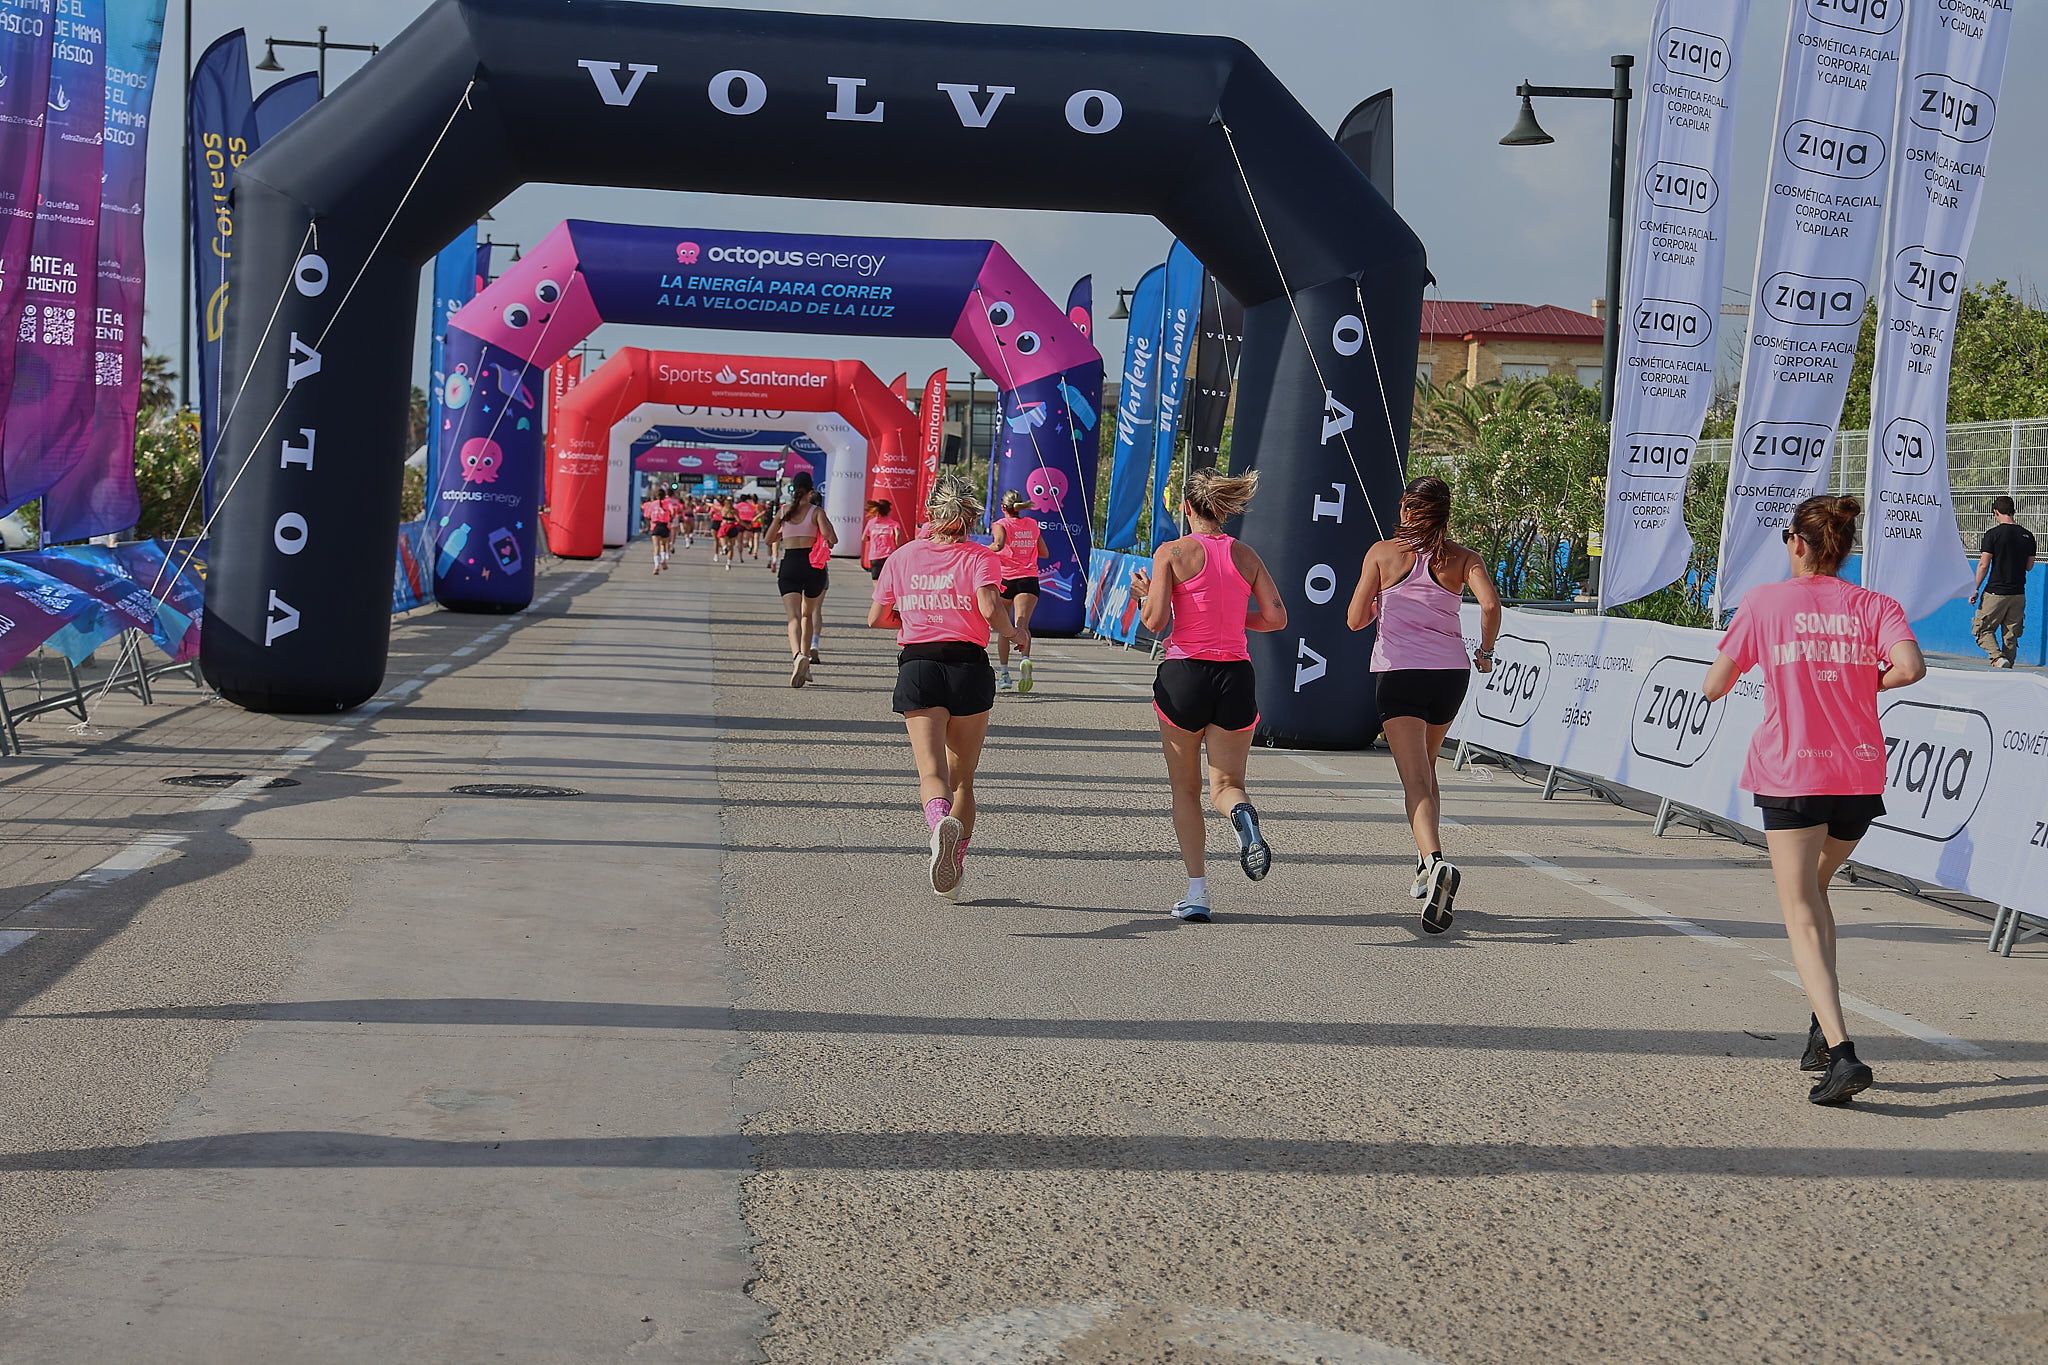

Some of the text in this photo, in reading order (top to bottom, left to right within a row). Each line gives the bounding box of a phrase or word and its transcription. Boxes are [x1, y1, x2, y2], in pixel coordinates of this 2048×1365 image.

[1940, 15, 1949, 28] Y
[72, 23, 102, 44] MAMA
[1797, 33, 1857, 56] COSMÉTICA
[1668, 39, 1722, 74] ziaja
[1817, 54, 1871, 76] CORPORAL
[1817, 70, 1867, 91] Y CAPILAR
[113, 90, 128, 105] EL
[577, 59, 1124, 135] VOLVO
[112, 109, 146, 129] MAMA
[1668, 101, 1712, 119] CORPORAL
[1920, 89, 1978, 132] ziaja
[1668, 115, 1710, 132] Y CAPILAR
[61, 132, 96, 146] AstraZeneca
[1796, 133, 1868, 171] ziaja
[1654, 173, 1707, 206] ziaja
[1774, 183, 1882, 208] COSMÉTICA FACIAL,
[1926, 186, 1933, 199] Y
[1795, 204, 1854, 222] CORPORAL
[1795, 220, 1849, 237] Y CAPILAR
[1652, 237, 1698, 253] CORPORAL
[707, 246, 886, 277] octopus energy
[1653, 251, 1696, 266] Y CAPILAR
[63, 262, 78, 277] AL
[660, 274, 893, 301] LA ENERGÍA PARA CORRER
[657, 293, 895, 318] A LA VELOCIDAD DE LA LUZ
[1775, 285, 1852, 320] ziaja
[113, 313, 124, 327] AL
[1639, 310, 1697, 341] ziaja
[1753, 335, 1818, 352] COSMÉTICA
[1676, 361, 1712, 373] FACIAL,
[1774, 354, 1838, 369] CORPORAL
[659, 364, 827, 388] Sports Santander
[1640, 372, 1689, 385] CORPORAL
[1773, 370, 1834, 383] Y CAPILAR
[1118, 336, 1152, 446] Marlene
[1642, 386, 1687, 399] Y CAPILAR
[927, 380, 942, 453] Santander
[816, 424, 850, 432] OYSHO
[265, 253, 329, 647] VOLVO
[566, 451, 604, 461] Santander
[1629, 445, 1689, 472] ziaja
[1752, 434, 1826, 466] ziaja
[880, 465, 917, 475] Santander
[442, 488, 522, 507] octopus energy
[1617, 489, 1666, 501] OSMÉTICA
[1734, 483, 1795, 498] COSMÉTICA
[1294, 314, 1364, 692] VOLVO
[1906, 493, 1942, 508] FACIAL,
[1048, 521, 1083, 537] energy
[1634, 520, 1640, 529] Y
[1756, 516, 1764, 527] Y
[1884, 527, 1923, 540] CAPILAR
[911, 573, 954, 590] SOMOS
[896, 593, 973, 612] IMPARABLES
[1794, 612, 1860, 638] SOMOS
[1774, 640, 1878, 666] IMPARABLES
[1817, 669, 1838, 682] 2026
[1485, 657, 1541, 713] ziaja
[1643, 684, 1712, 751] ziaja
[1797, 748, 1833, 759] OYSHO
[1884, 736, 1973, 819] ziaja
